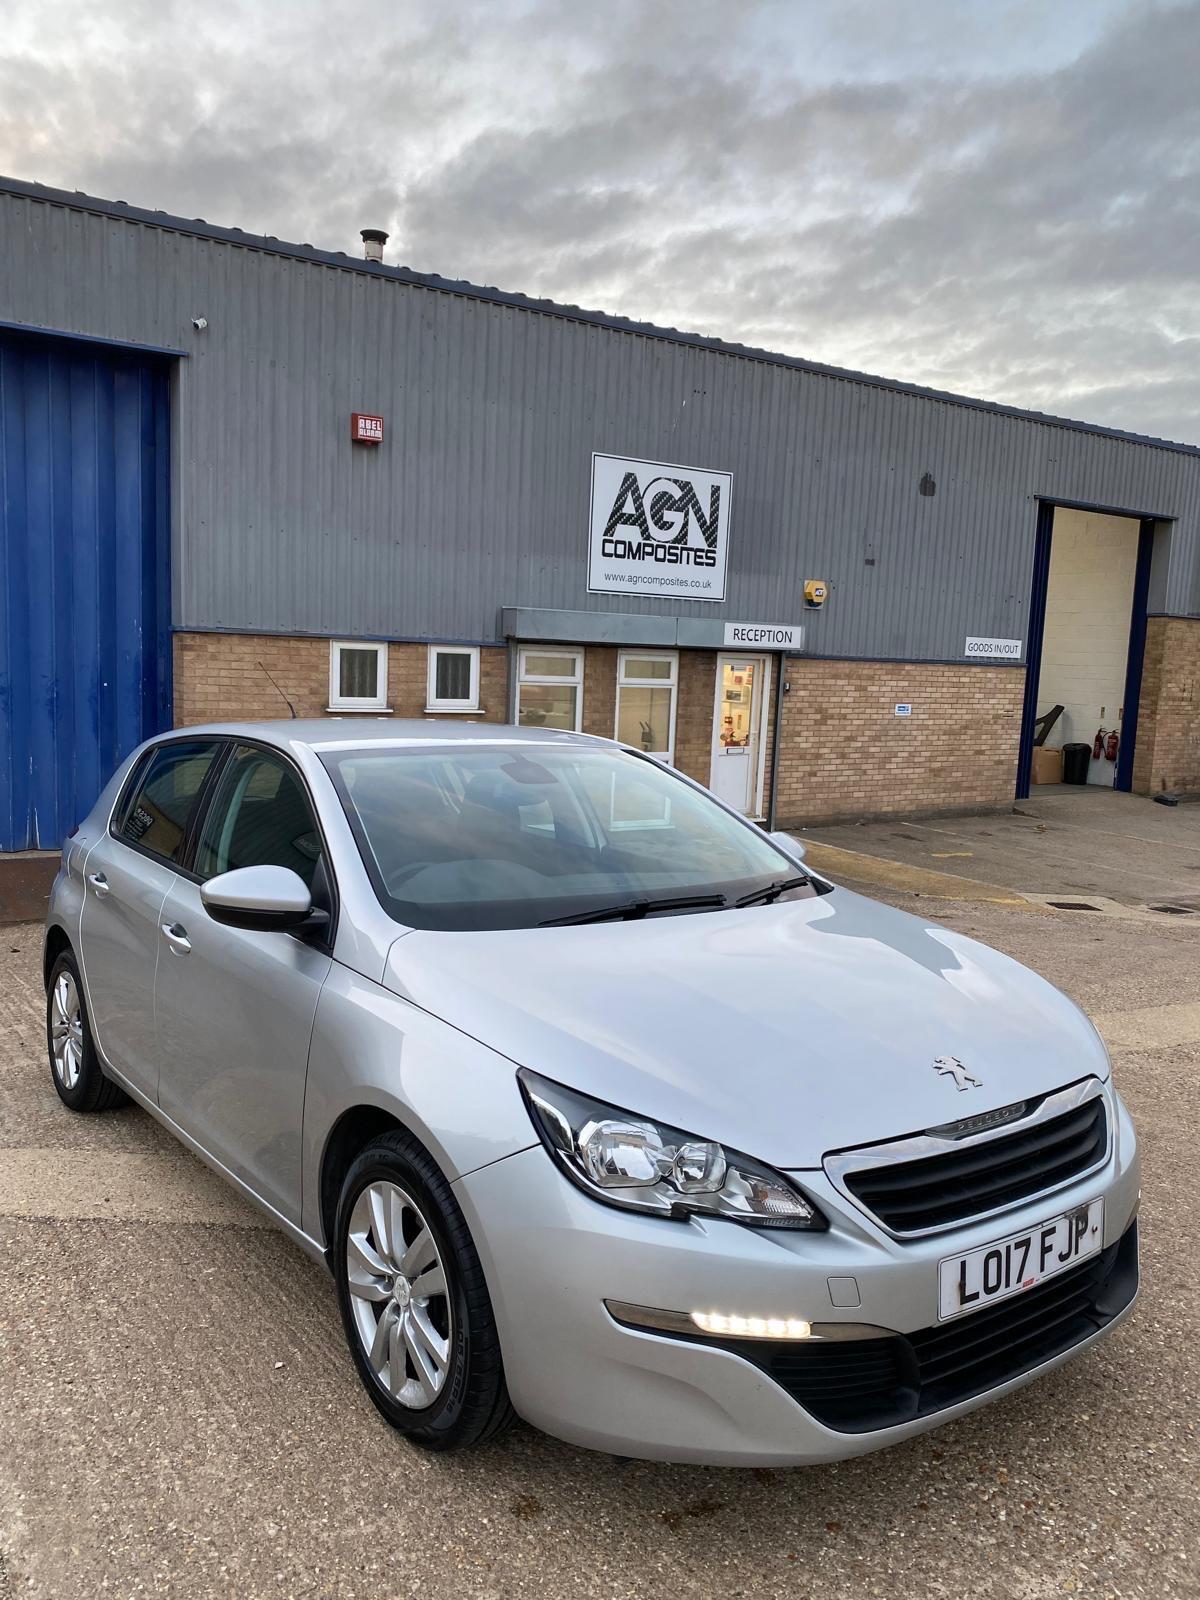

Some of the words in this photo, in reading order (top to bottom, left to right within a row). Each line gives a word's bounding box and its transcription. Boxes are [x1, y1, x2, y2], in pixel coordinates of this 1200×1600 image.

[360, 419, 381, 430] ABEL
[603, 472, 720, 548] AGN
[602, 538, 717, 567] COMPOSITES
[604, 573, 712, 589] www.agncomposites.co.uk
[733, 628, 793, 643] RECEPTION
[967, 643, 993, 653] GOODS
[994, 644, 1019, 654] IN/OUT
[958, 1106, 1017, 1130] PEUGEOT
[960, 1237, 1032, 1305] LO17
[1039, 1210, 1089, 1273] FJP
